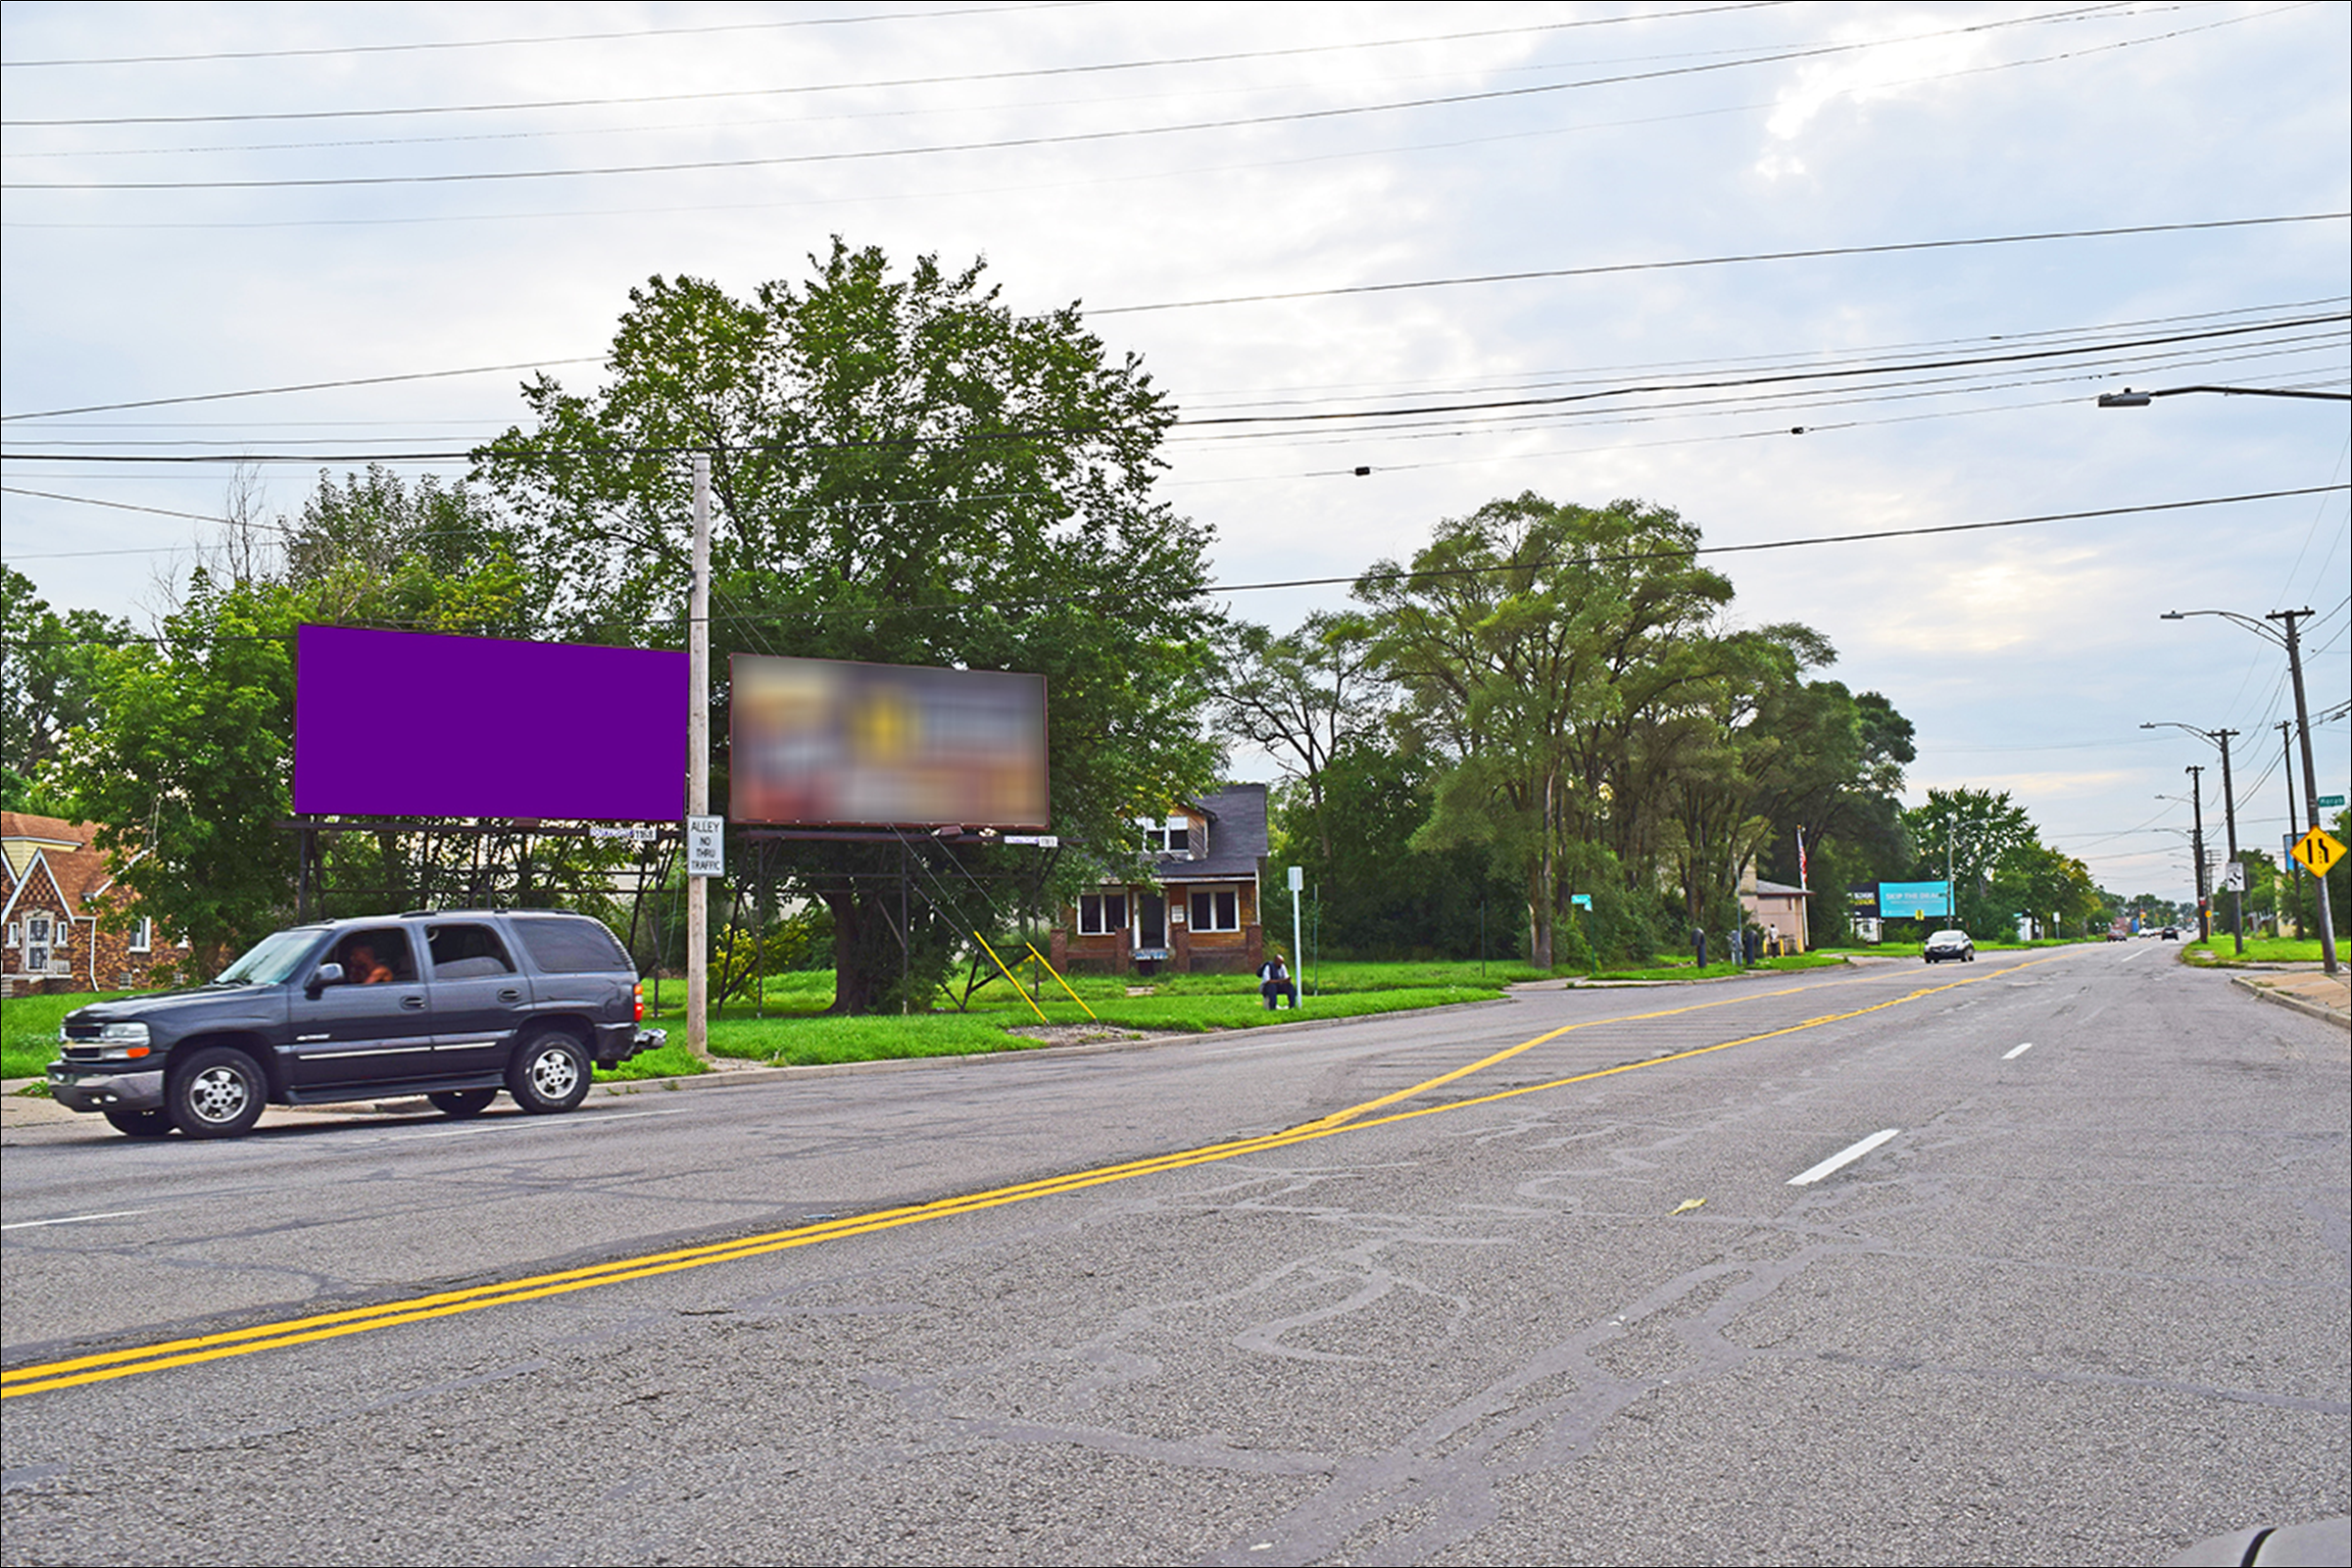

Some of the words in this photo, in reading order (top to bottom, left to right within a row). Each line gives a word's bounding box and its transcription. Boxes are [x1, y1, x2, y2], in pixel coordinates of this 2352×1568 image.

[691, 821, 720, 833] ALLEY
[700, 836, 711, 846] NO
[696, 848, 716, 858] THRU
[691, 860, 720, 870] TRAFFIC
